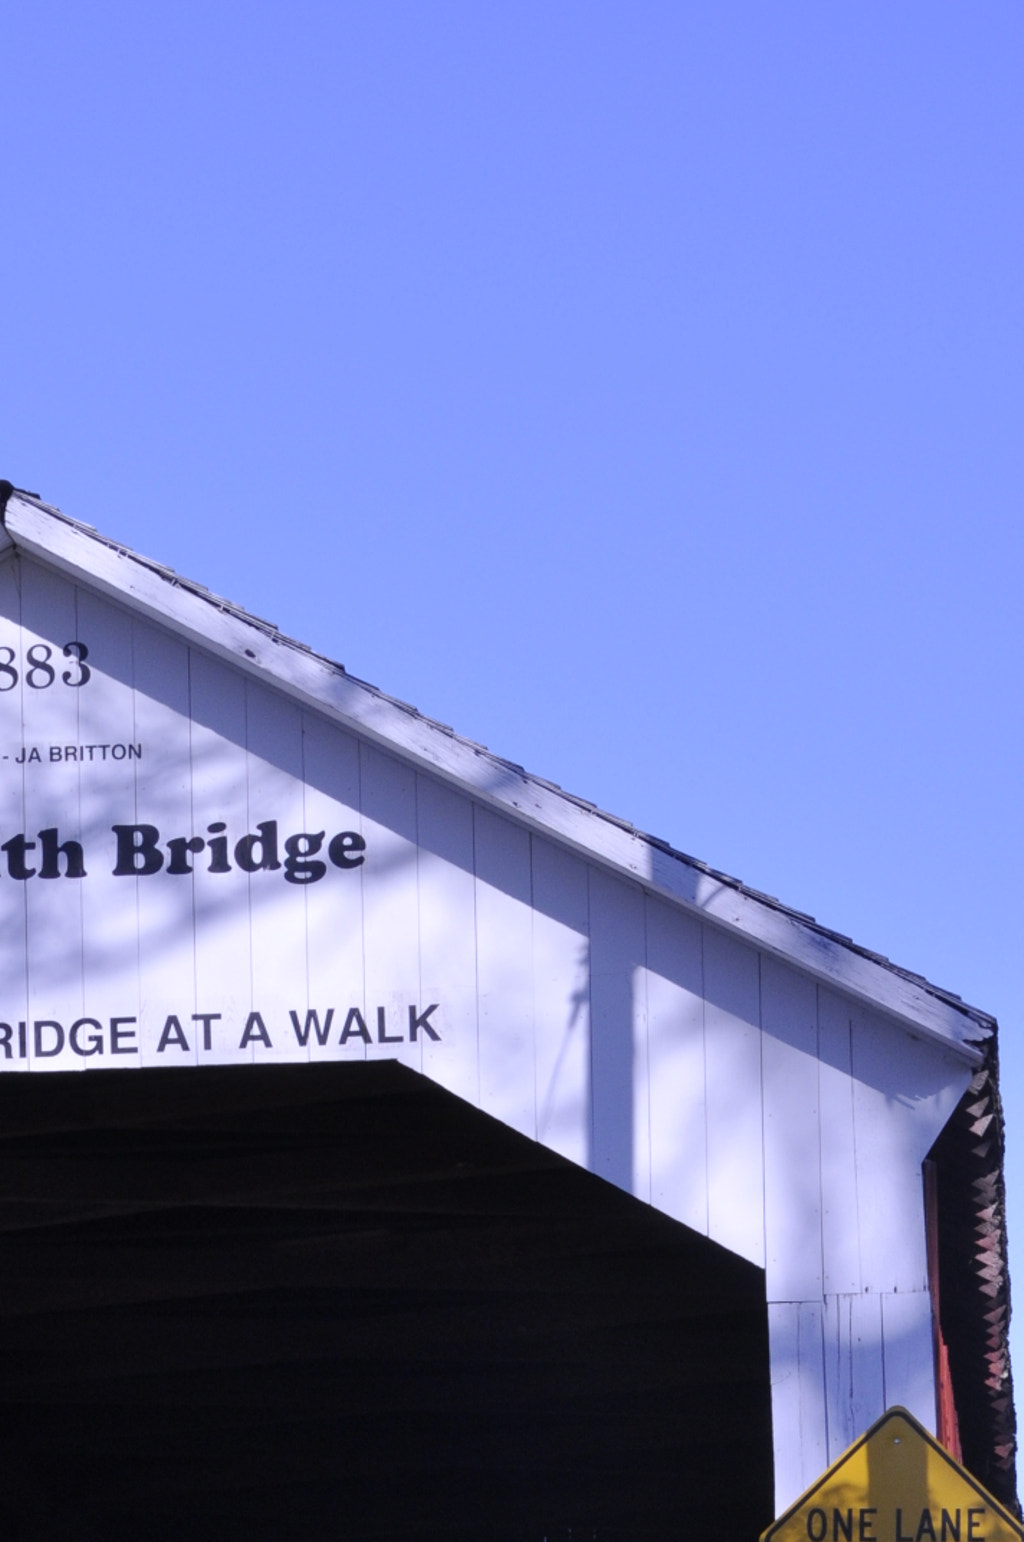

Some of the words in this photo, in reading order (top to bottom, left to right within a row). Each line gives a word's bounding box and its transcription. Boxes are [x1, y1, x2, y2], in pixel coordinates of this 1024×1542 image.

[15, 747, 42, 764] JA
[49, 743, 142, 762] BRITTON
[112, 821, 366, 884] Bridge
[157, 1013, 222, 1052] AT
[238, 1011, 273, 1050] A
[289, 1003, 442, 1047] WALK
[806, 1508, 878, 1542] ONE
[895, 1508, 986, 1542] LANE
